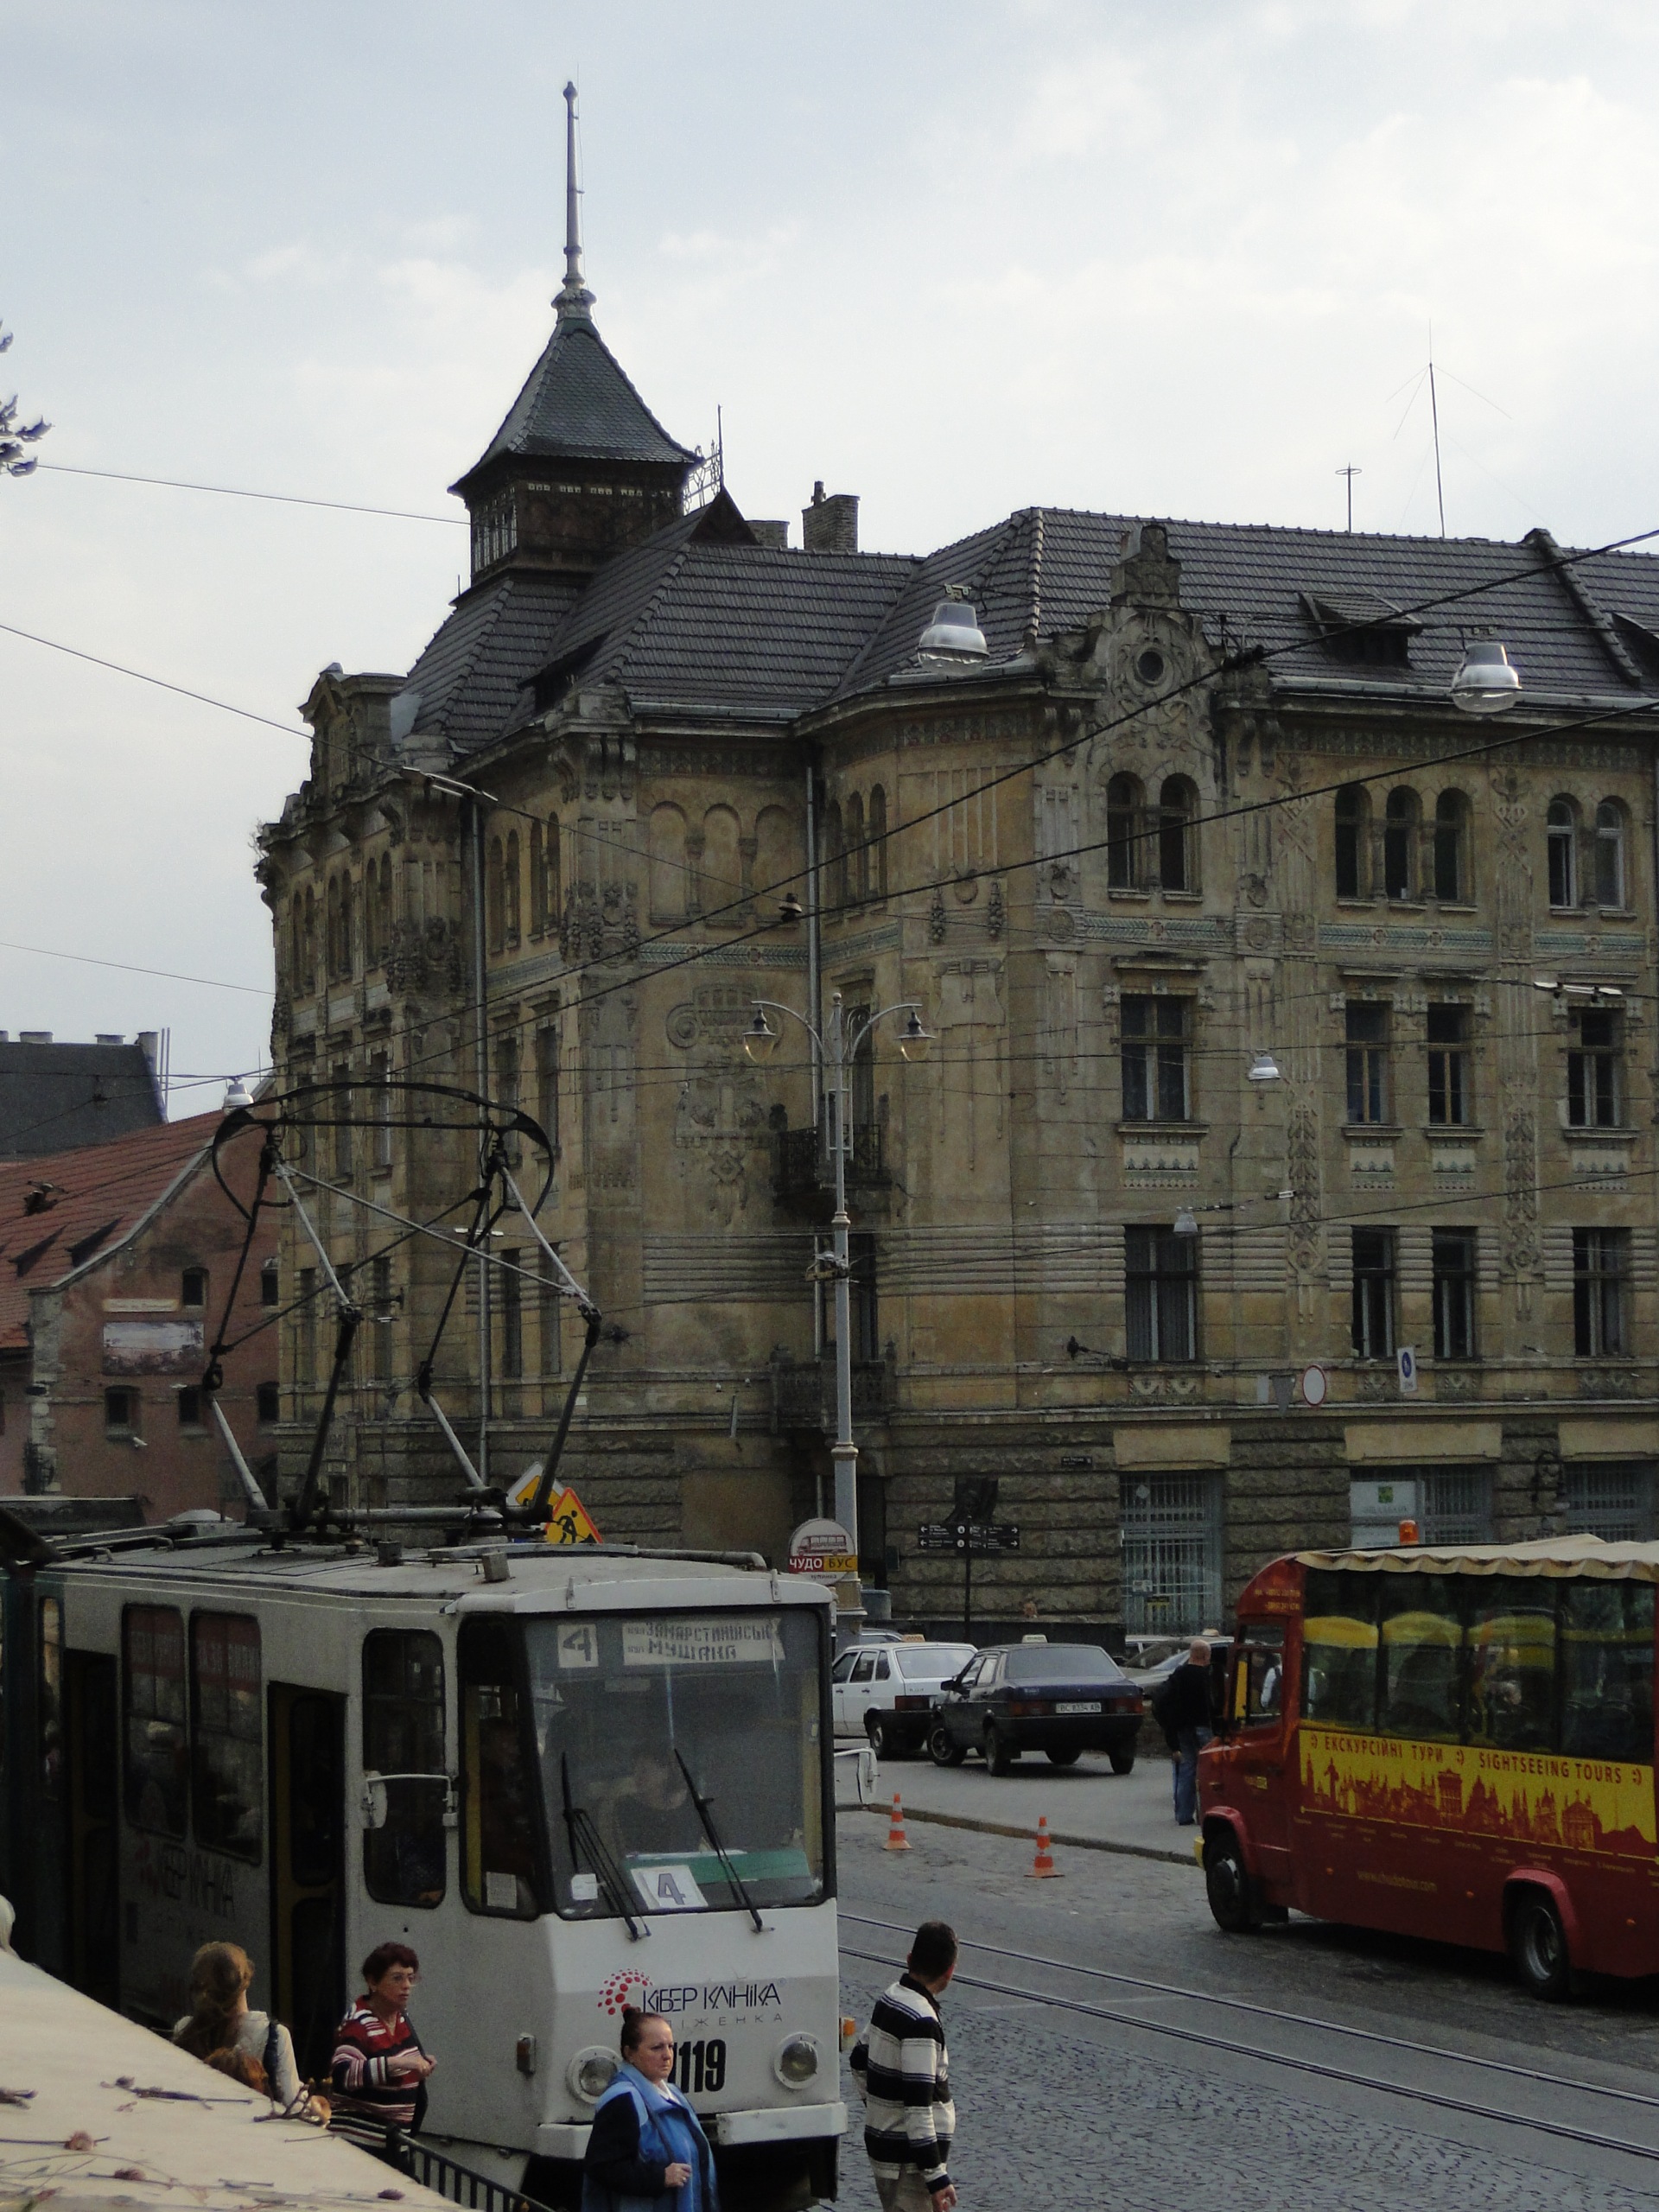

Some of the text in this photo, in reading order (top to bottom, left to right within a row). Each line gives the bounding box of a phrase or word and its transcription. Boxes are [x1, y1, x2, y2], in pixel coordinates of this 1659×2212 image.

[790, 1558, 853, 1570] ЧУДО БУС
[563, 1627, 591, 1662] 4
[1325, 1736, 1403, 1758] ЕКСКУРСІЙНІ
[1412, 1745, 1443, 1764] ТУРИ
[1479, 1751, 1569, 1777] SIGHTSEEING
[1575, 1764, 1622, 1783] TOURS
[658, 1872, 686, 1905] 4
[668, 2013, 783, 2027] ІЖЕНКА
